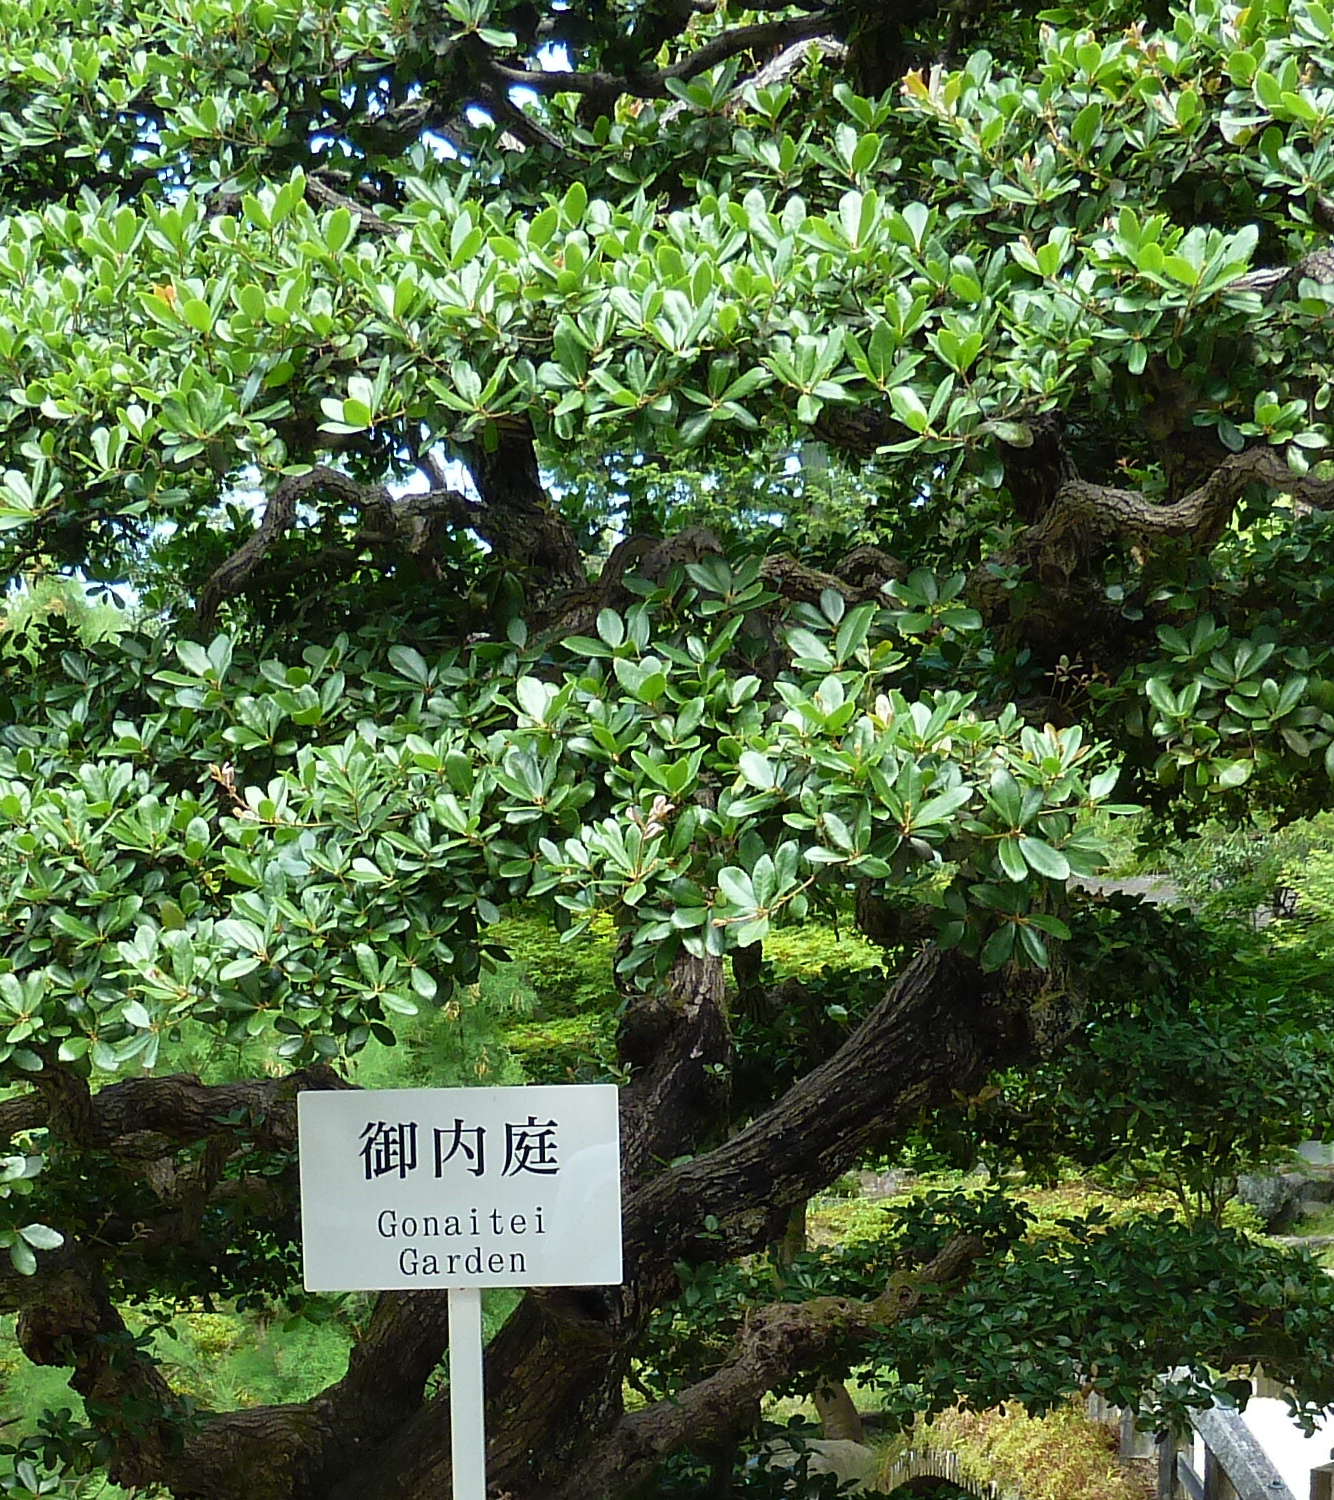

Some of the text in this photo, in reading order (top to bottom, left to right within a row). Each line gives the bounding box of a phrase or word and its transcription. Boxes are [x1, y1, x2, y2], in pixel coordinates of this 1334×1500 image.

[358, 1116, 560, 1180] 御内庭
[377, 1206, 546, 1238] Gonaitei
[399, 1246, 526, 1275] Garden
